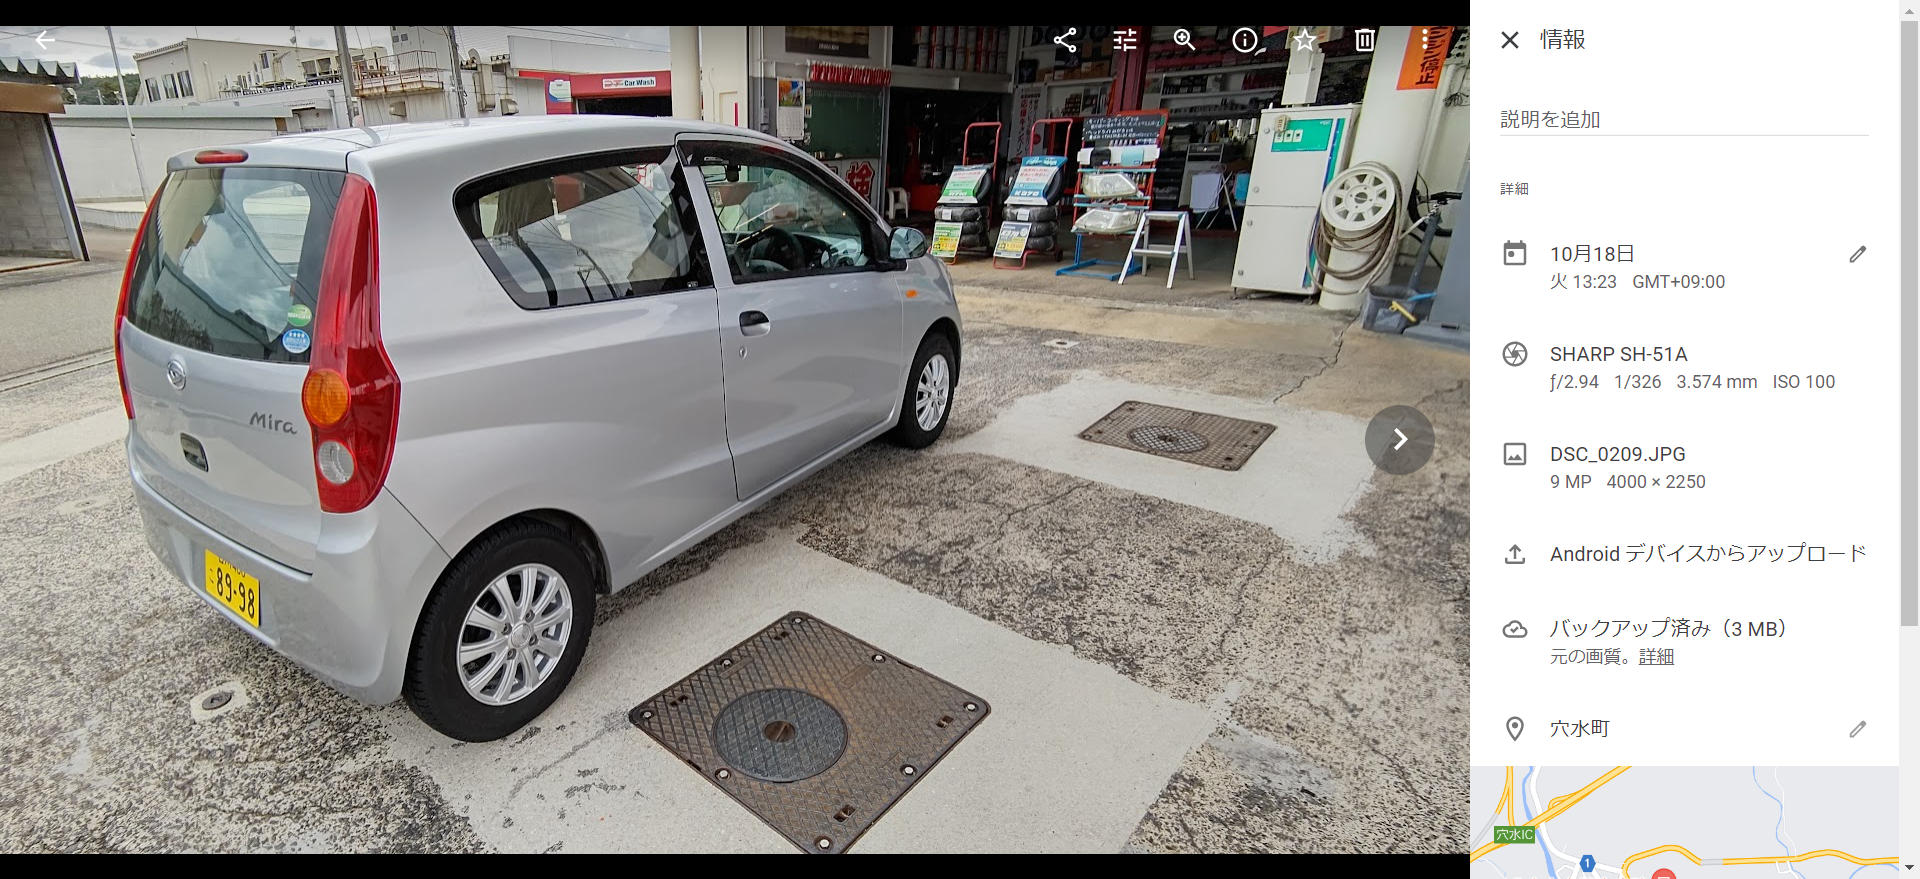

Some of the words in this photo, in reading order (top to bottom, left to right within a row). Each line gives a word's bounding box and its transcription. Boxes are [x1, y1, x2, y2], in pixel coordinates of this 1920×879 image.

[624, 79, 635, 87] Car
[636, 78, 655, 86] Wash
[249, 411, 298, 435] Mira
[216, 567, 255, 619] 89-98
